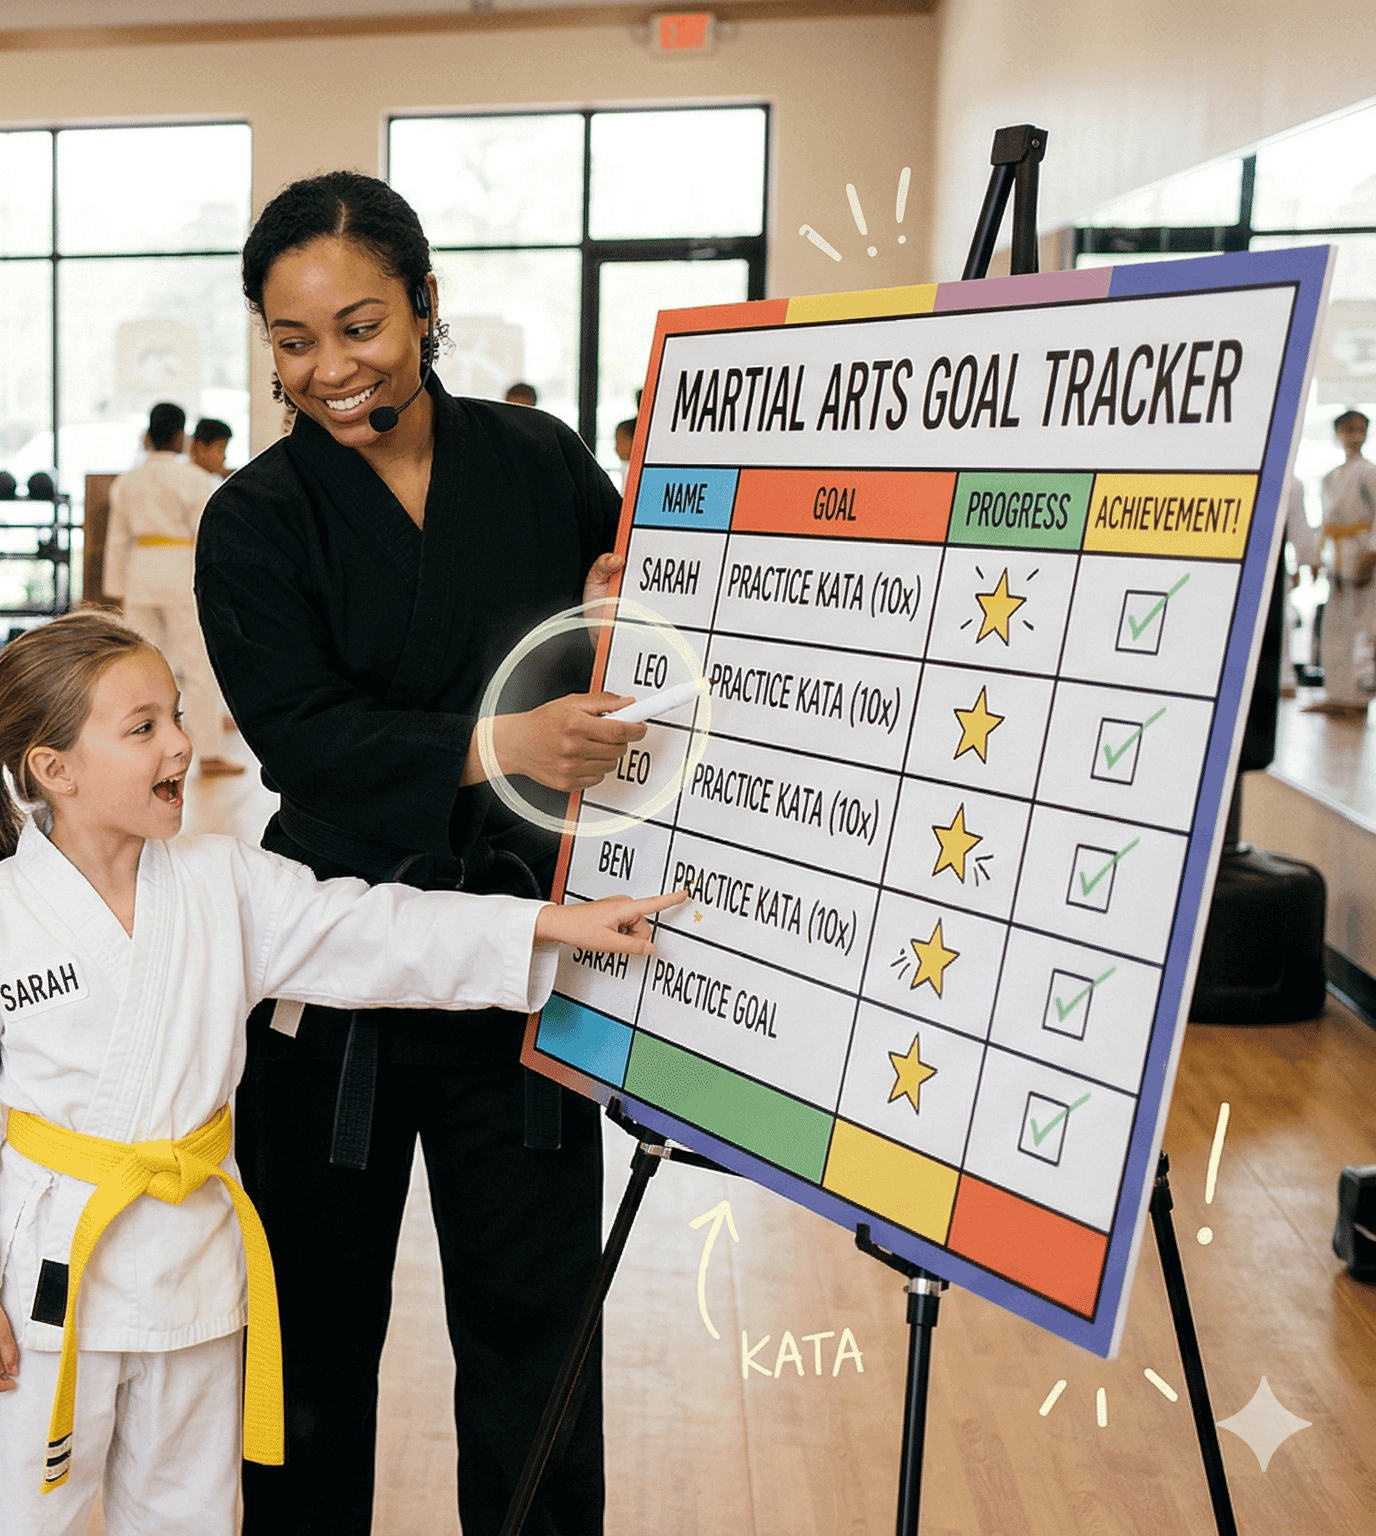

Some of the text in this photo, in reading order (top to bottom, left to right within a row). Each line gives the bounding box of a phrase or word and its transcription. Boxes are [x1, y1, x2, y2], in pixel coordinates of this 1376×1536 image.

[670, 338, 1243, 433] MARTIAL ARTS GOAL TRACKER
[662, 482, 708, 515] NAME
[813, 486, 857, 522] GOAL
[965, 491, 1071, 530] PROGRESS
[1095, 495, 1238, 533] ACHIEVEMENT!
[639, 557, 701, 595] SARAH
[727, 563, 921, 622] PRACTICE KATA (10x)
[633, 652, 668, 689] LEO
[709, 663, 901, 735] PRACTICE KATA (10x)
[616, 749, 651, 785] LEO
[690, 763, 879, 846] PRACTICE KATA (10x)
[598, 840, 635, 881] BEN
[672, 861, 857, 956] PRACTICE KATA (10x)
[0, 963, 79, 1012] SARAH
[652, 958, 777, 1039] PRACTICE GOAL
